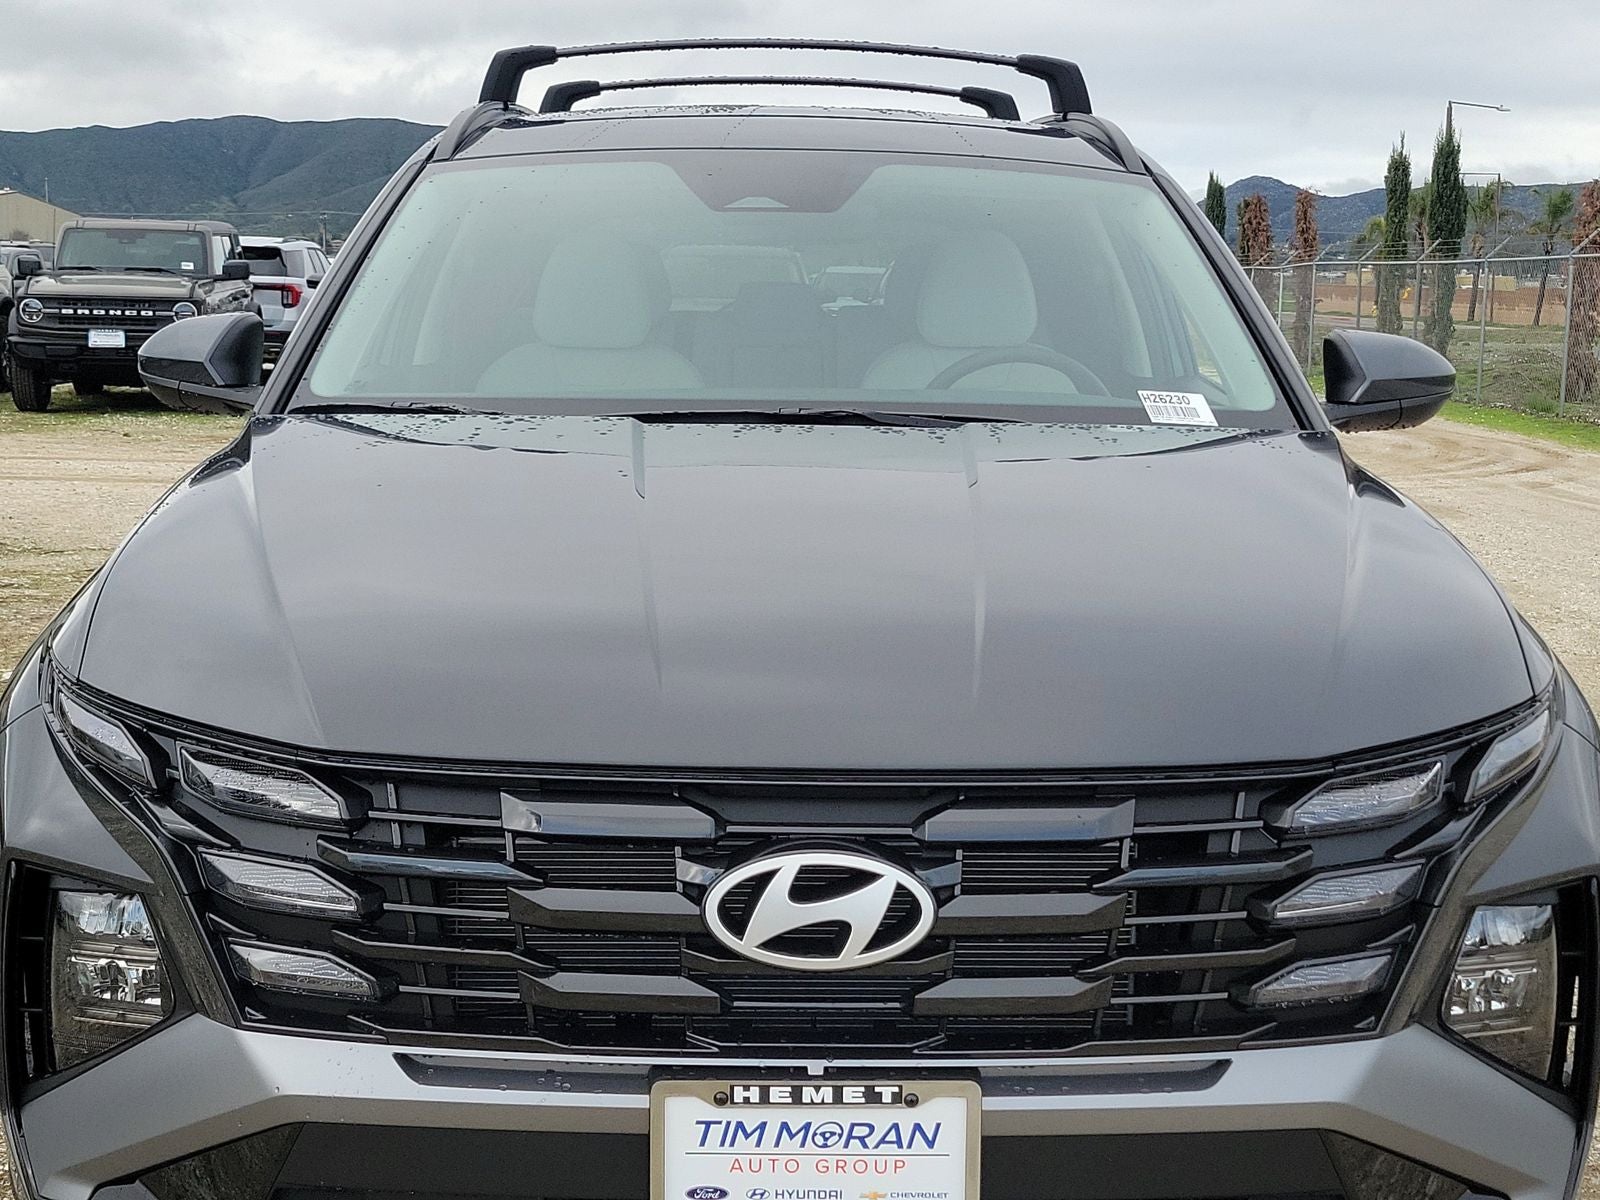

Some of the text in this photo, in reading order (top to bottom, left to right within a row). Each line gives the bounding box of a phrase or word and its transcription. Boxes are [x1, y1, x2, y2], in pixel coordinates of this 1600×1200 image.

[61, 308, 154, 316] BRONCO
[1141, 393, 1191, 405] H26230
[732, 1085, 899, 1103] HEMET
[694, 1119, 942, 1150] TIM MORAN
[729, 1158, 907, 1174] AUTO GROUP
[693, 1188, 721, 1199] Ford
[775, 1189, 843, 1200] HYUNDAI
[890, 1191, 950, 1199] CHEVROLET
